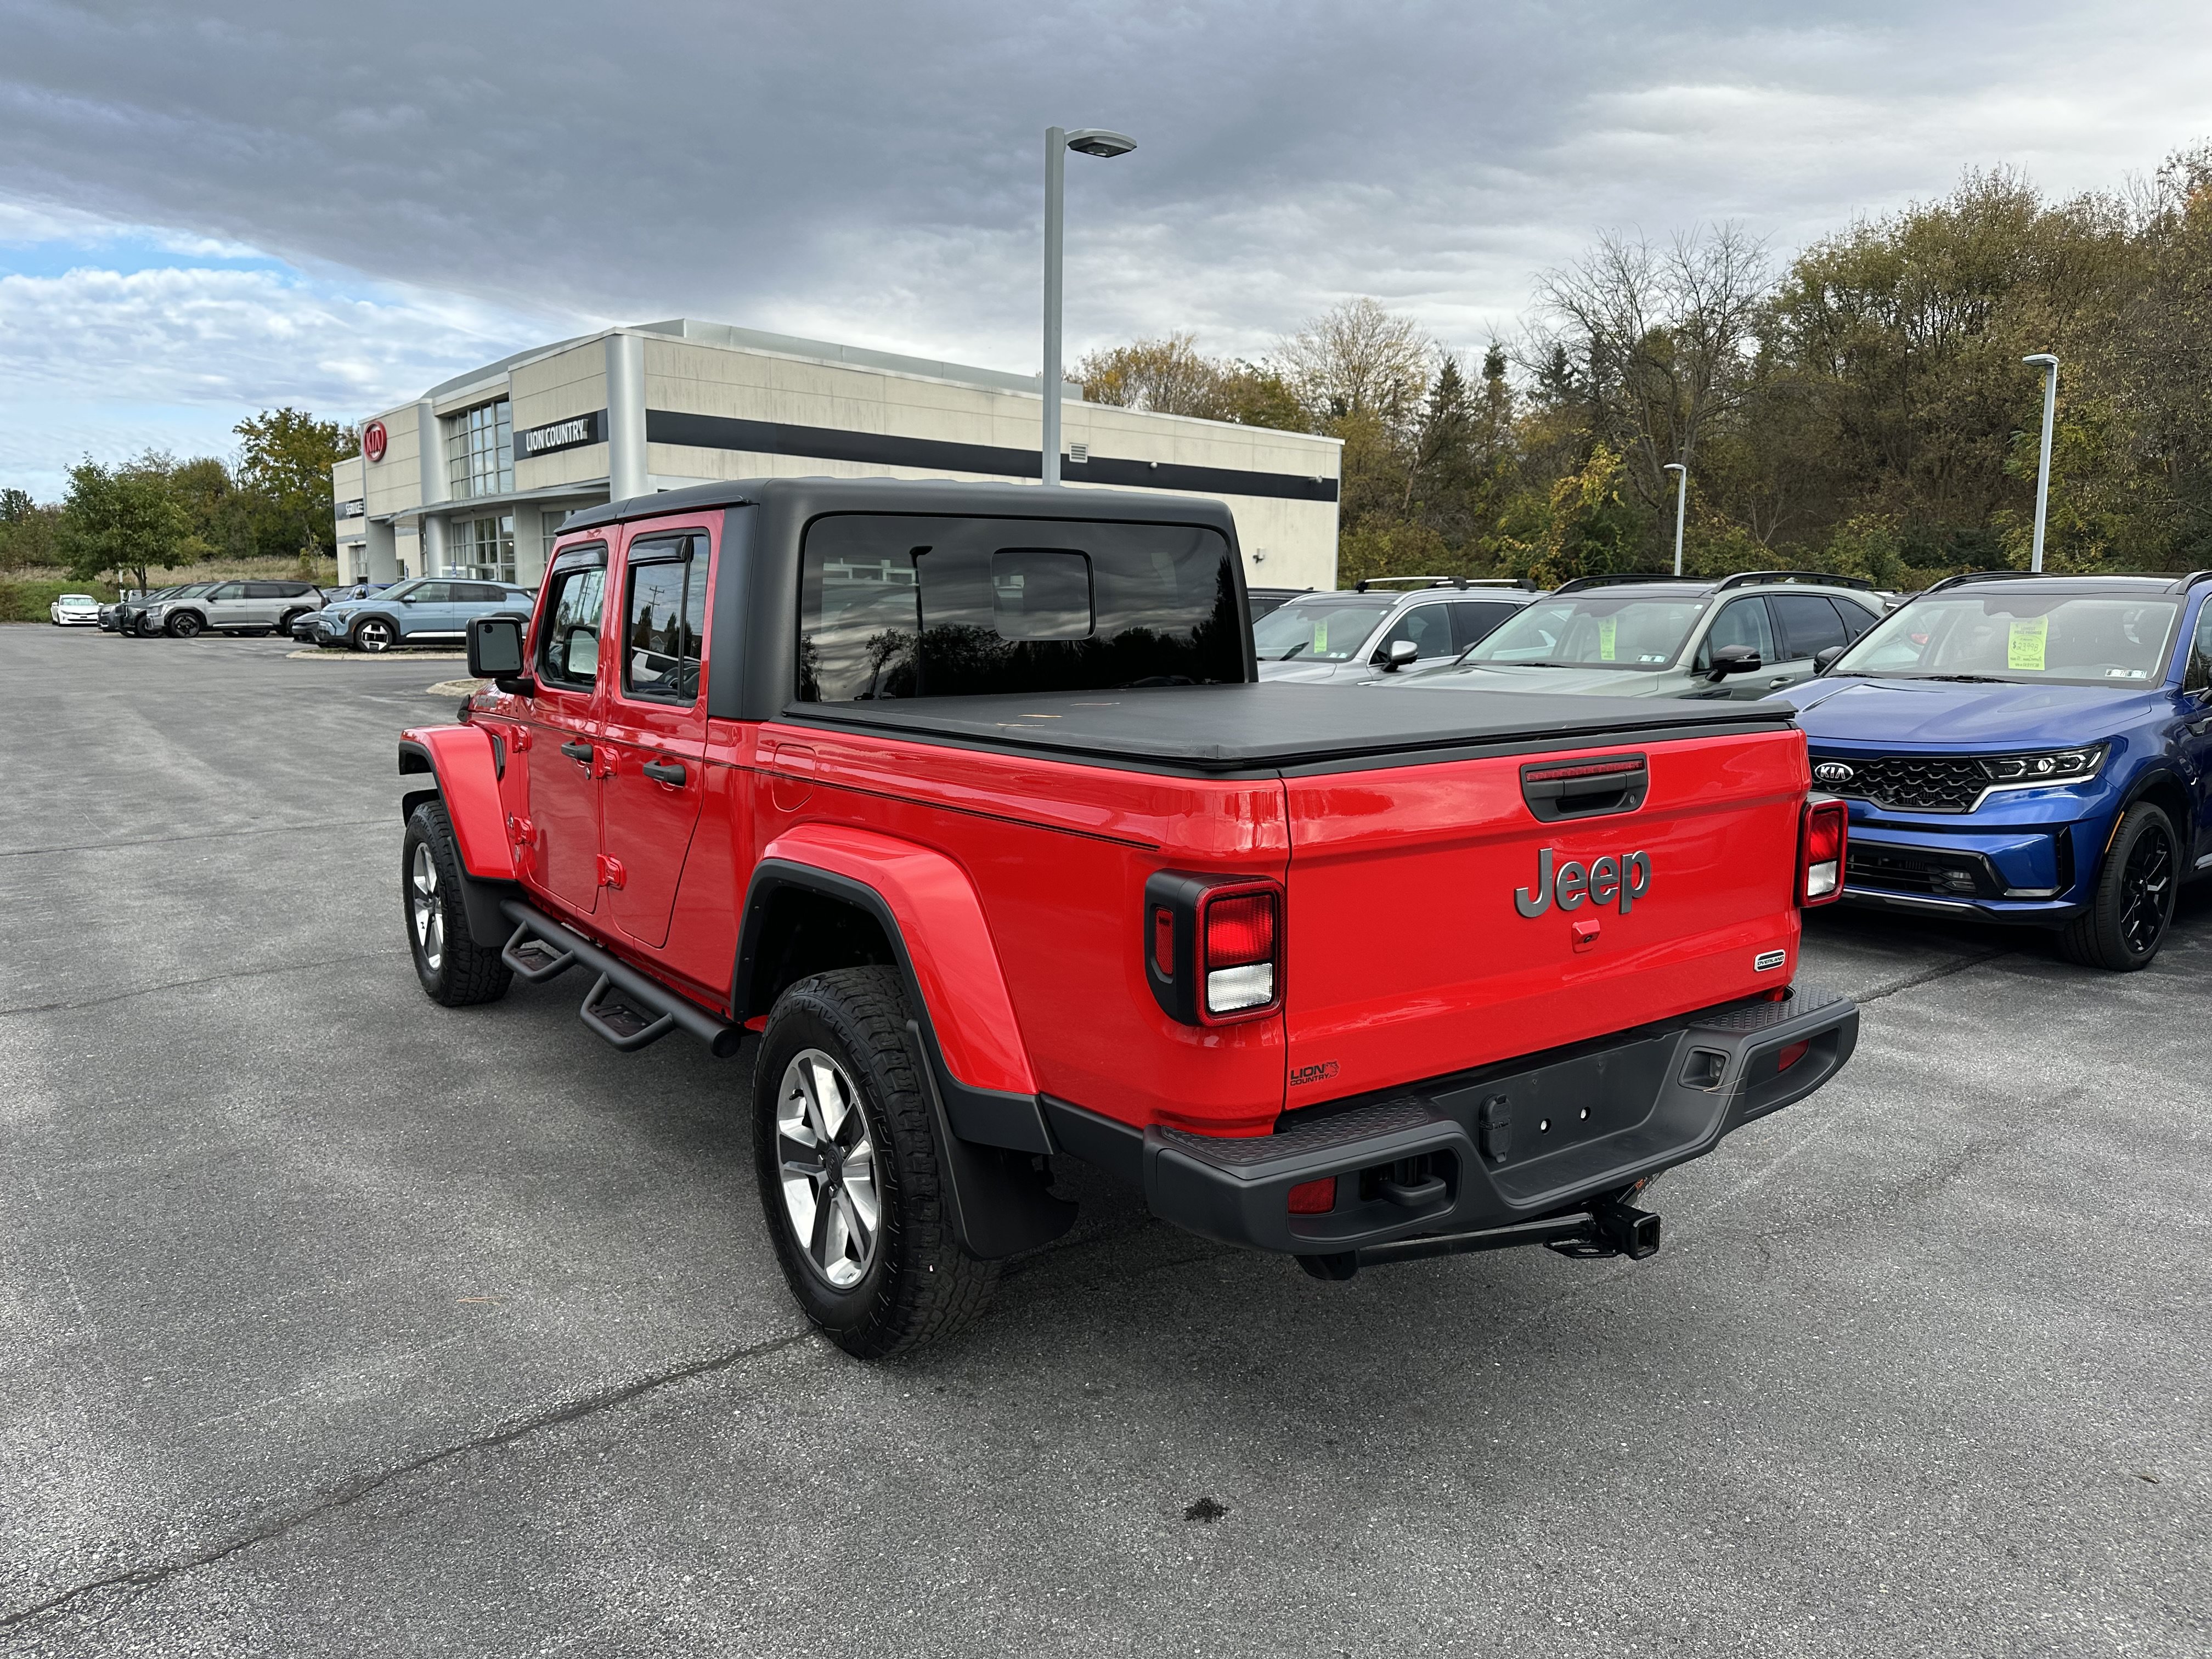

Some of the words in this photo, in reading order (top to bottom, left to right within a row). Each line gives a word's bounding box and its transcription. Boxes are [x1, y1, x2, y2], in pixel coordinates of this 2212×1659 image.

[366, 430, 381, 453] KIA
[526, 429, 544, 452] LION
[545, 419, 584, 447] COUNTRY
[1820, 766, 1846, 779] KIA
[1514, 848, 1651, 918] Jeep
[1758, 956, 1785, 966] OVERLAND
[1290, 1063, 1325, 1080] LION
[1290, 1073, 1330, 1086] COUNTRY
